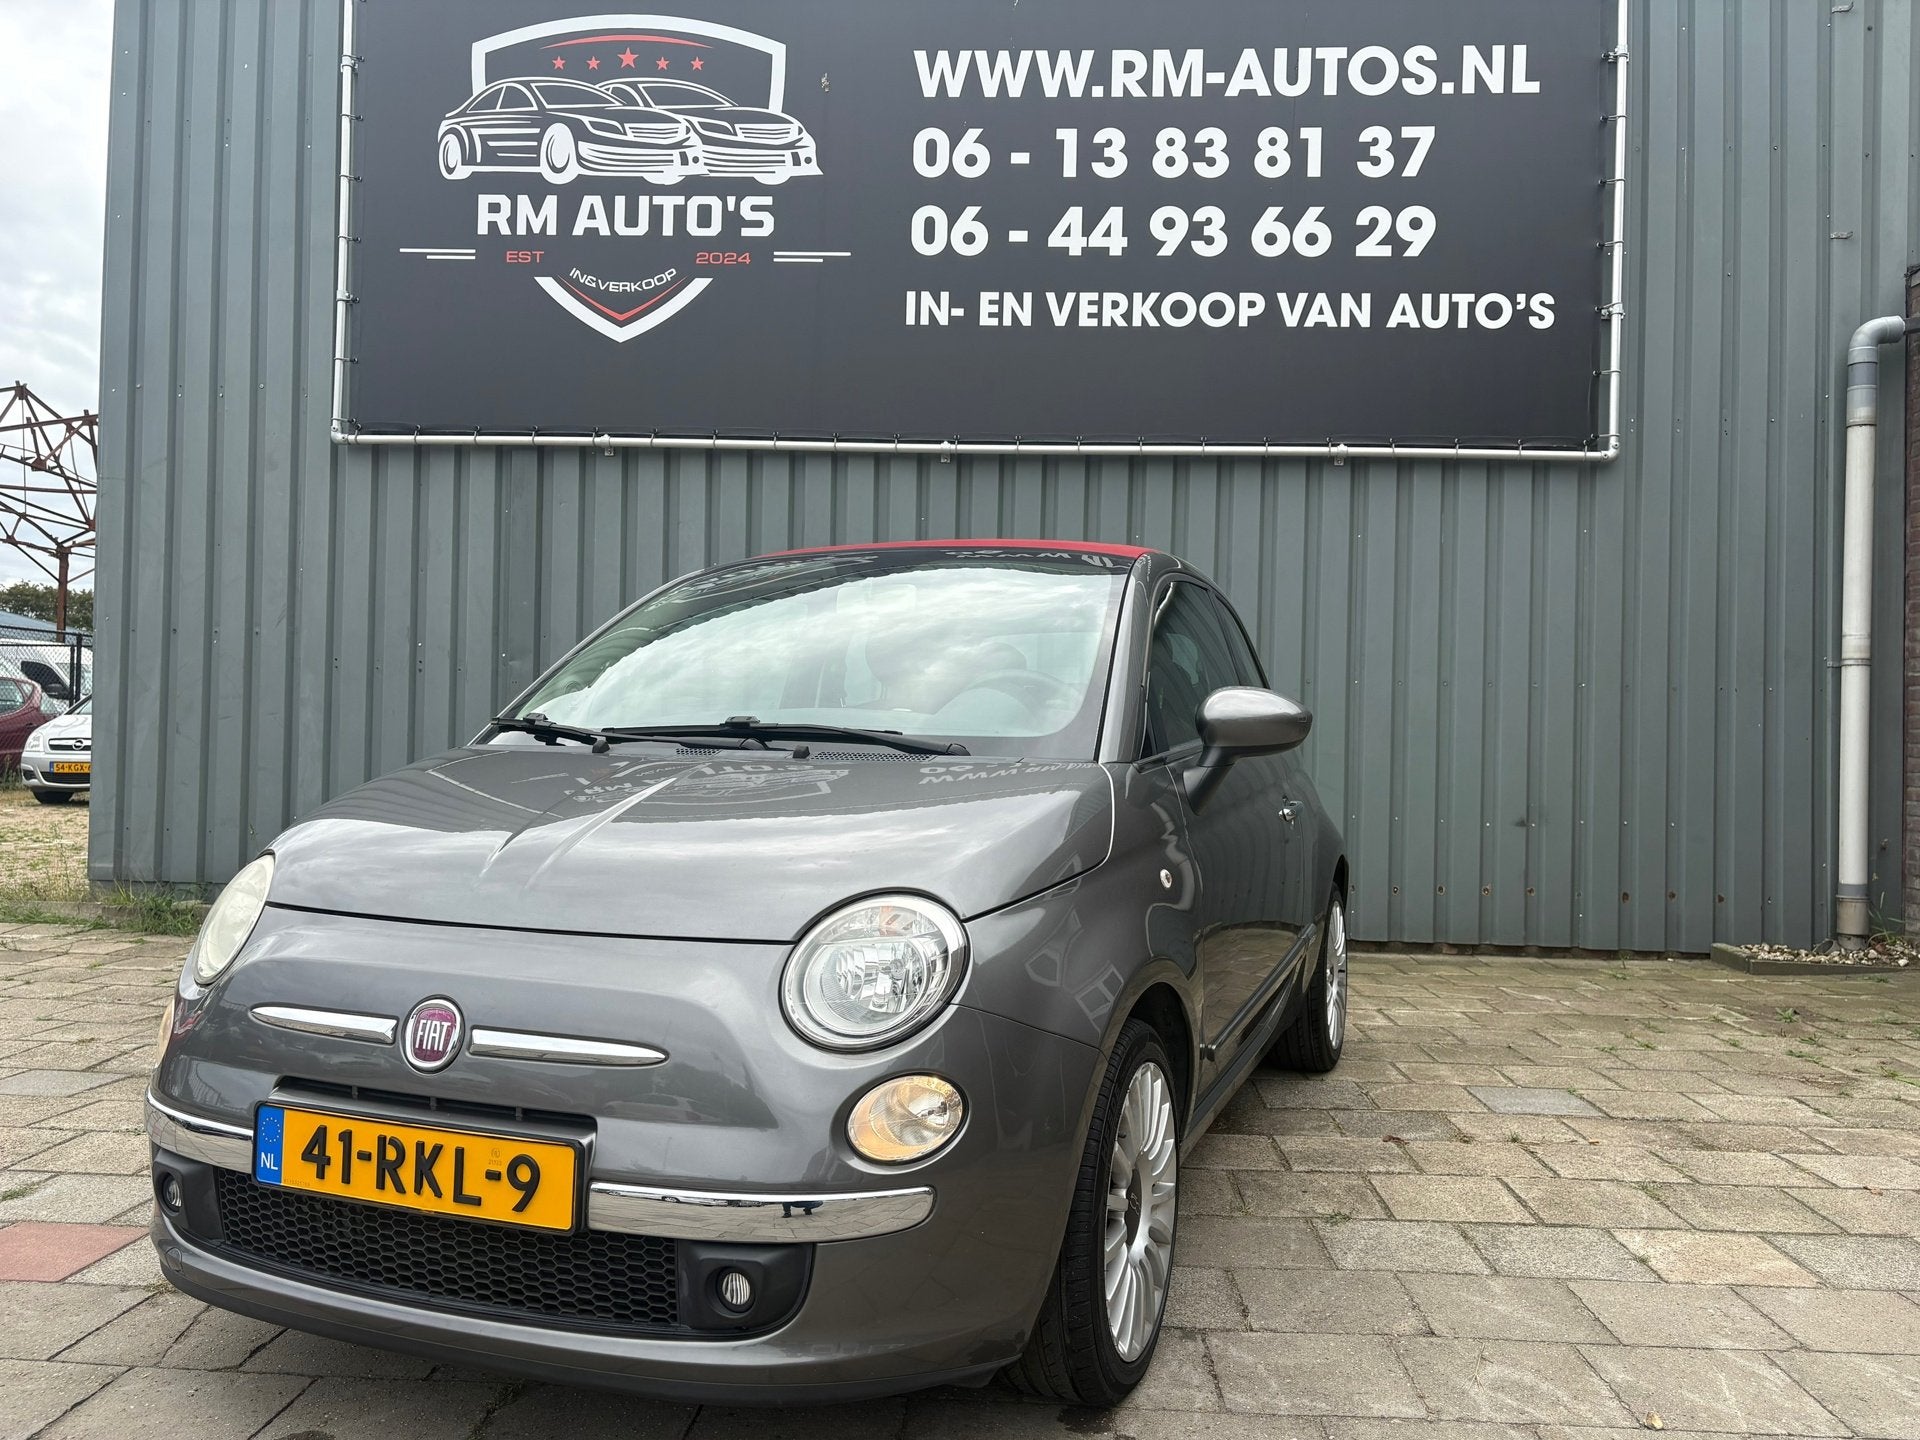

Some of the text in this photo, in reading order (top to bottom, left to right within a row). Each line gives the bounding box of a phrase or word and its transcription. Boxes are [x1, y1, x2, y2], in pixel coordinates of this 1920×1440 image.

[914, 44, 1540, 98] WWW.RM-AUTOS.NL
[912, 125, 1436, 179] 06 - 13 83 81 37
[477, 193, 775, 237] RM AUTO'S
[910, 204, 1437, 258] 06 - 44 93 66 29
[506, 251, 752, 265] EST 2024
[569, 267, 677, 293] IN&VERKOOP
[905, 290, 965, 327] IN-
[979, 291, 1033, 327] EN
[1045, 291, 1266, 328] VERKOOP
[1275, 292, 1372, 328] VAN
[415, 1019, 452, 1051] FIAT
[261, 1151, 279, 1170] NL
[301, 1124, 541, 1213] 41-RKL-9
